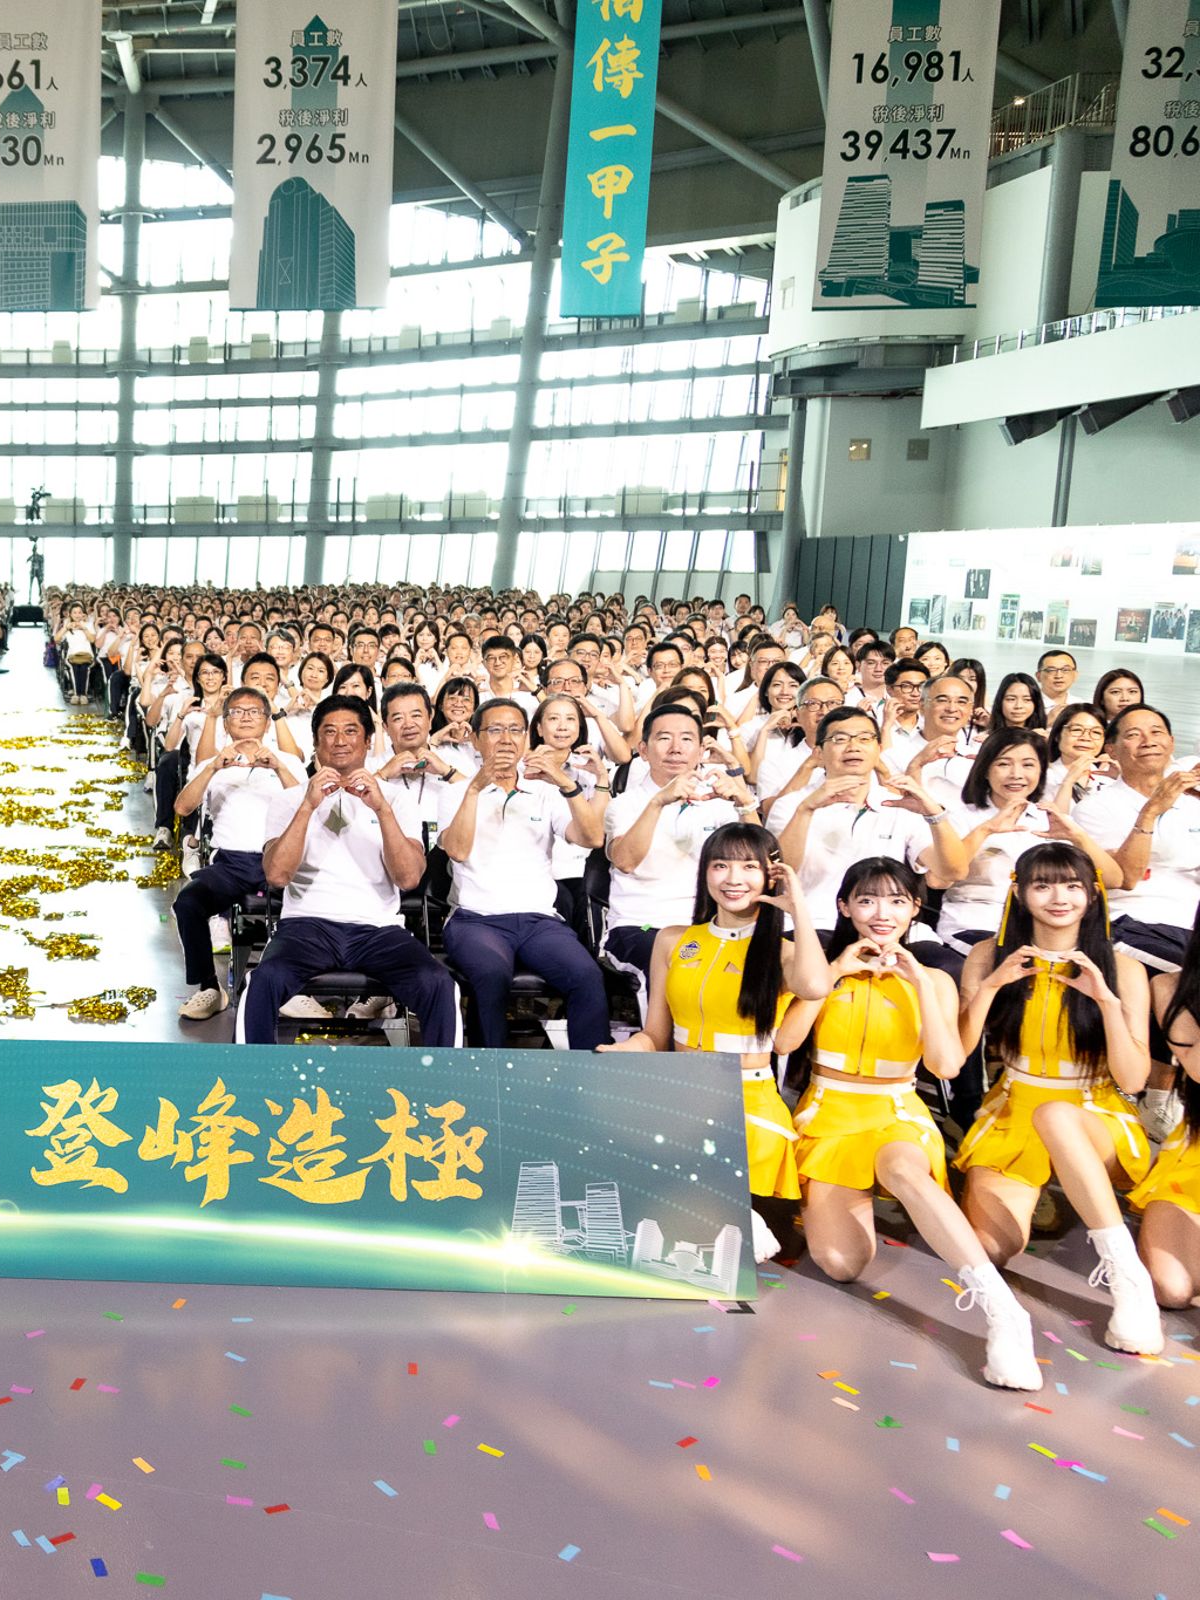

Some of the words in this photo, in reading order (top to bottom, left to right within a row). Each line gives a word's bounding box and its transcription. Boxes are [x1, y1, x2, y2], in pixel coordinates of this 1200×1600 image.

[290, 29, 343, 47] 員工數
[888, 25, 942, 43] 員工數
[1141, 46, 1200, 82] 32,
[24, 1076, 490, 1208] 登峰造極
